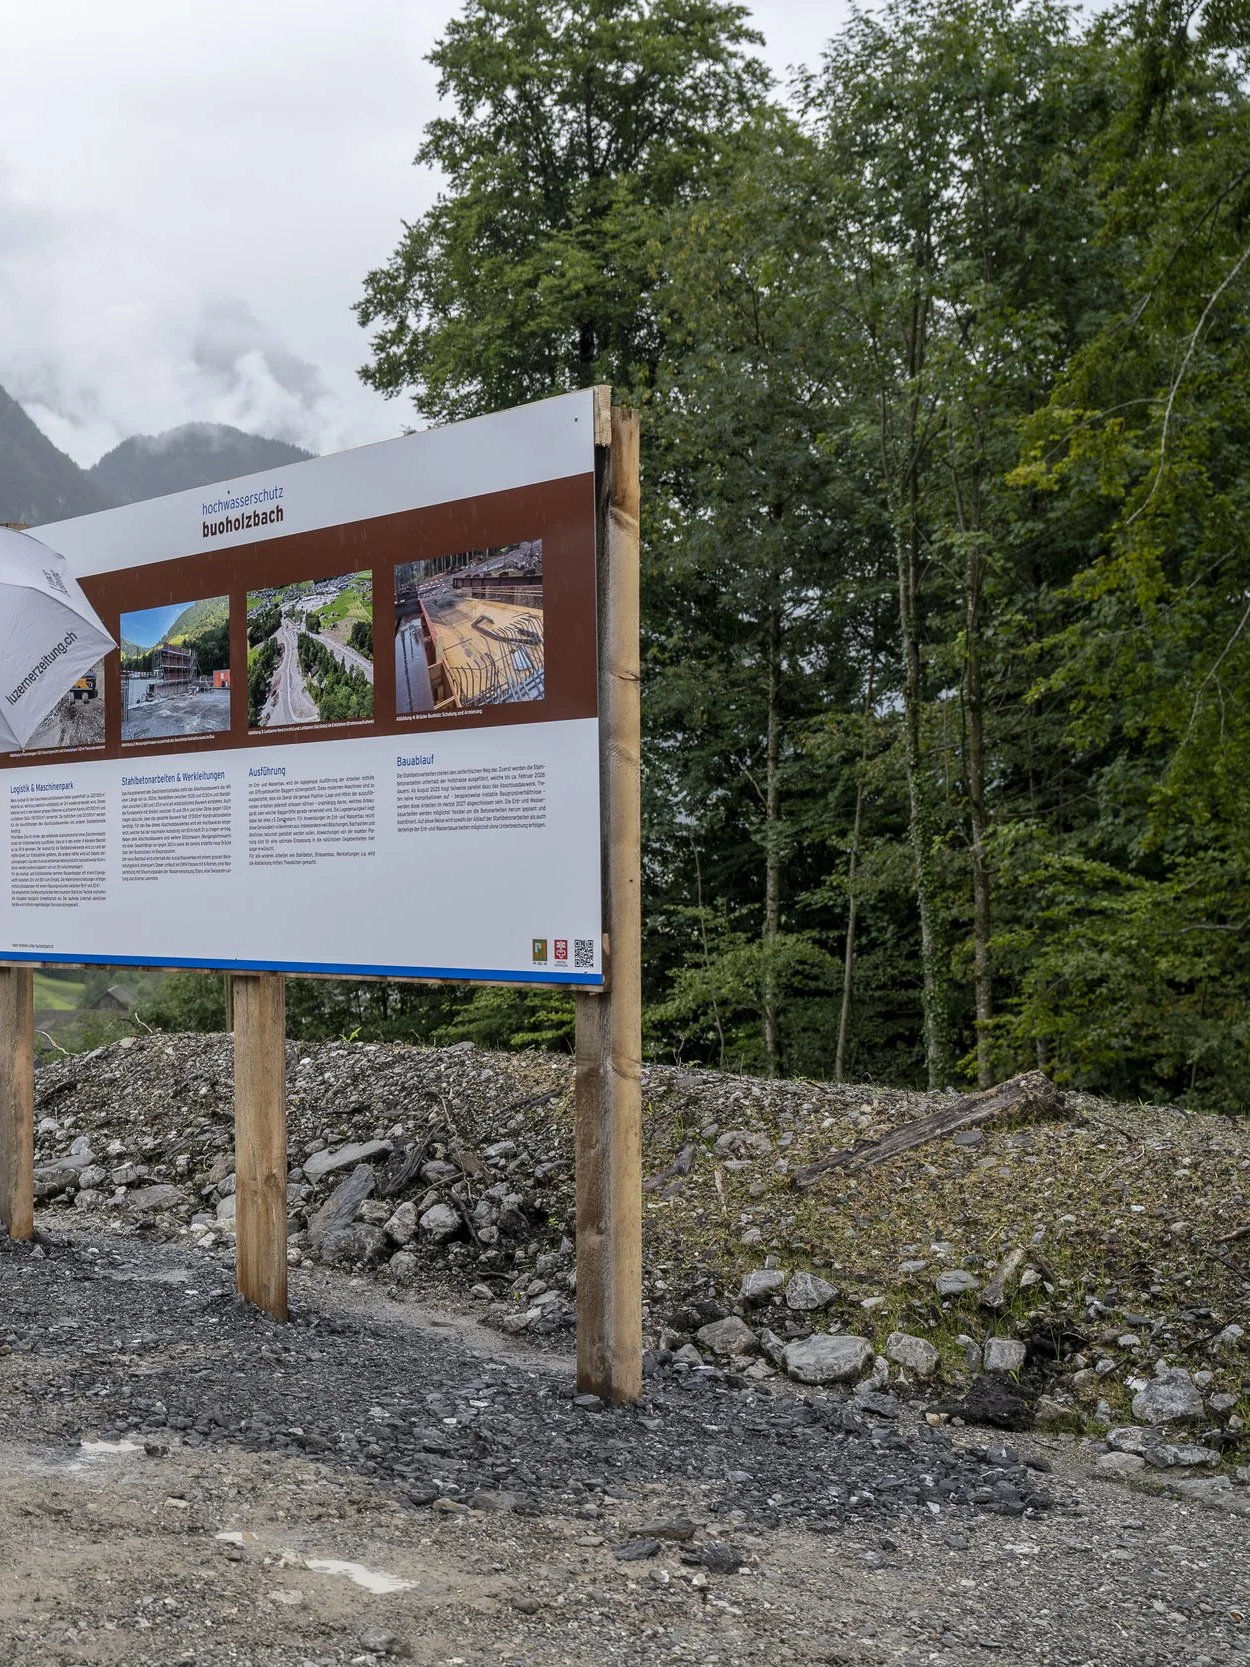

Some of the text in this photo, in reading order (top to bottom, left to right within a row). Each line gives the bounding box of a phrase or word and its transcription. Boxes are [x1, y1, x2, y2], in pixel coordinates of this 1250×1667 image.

[202, 485, 284, 515] hochwasserschutz
[202, 504, 283, 538] buoholzbach
[5, 630, 78, 705] luzernerzeitung.ch
[397, 754, 434, 766] Bauablauf
[122, 771, 225, 785] Stahlbetonarbeiten & Werkleitungen
[249, 766, 285, 777] Ausführung
[10, 785, 29, 794] Logistik
[36, 781, 74, 792] Maschinenpark
